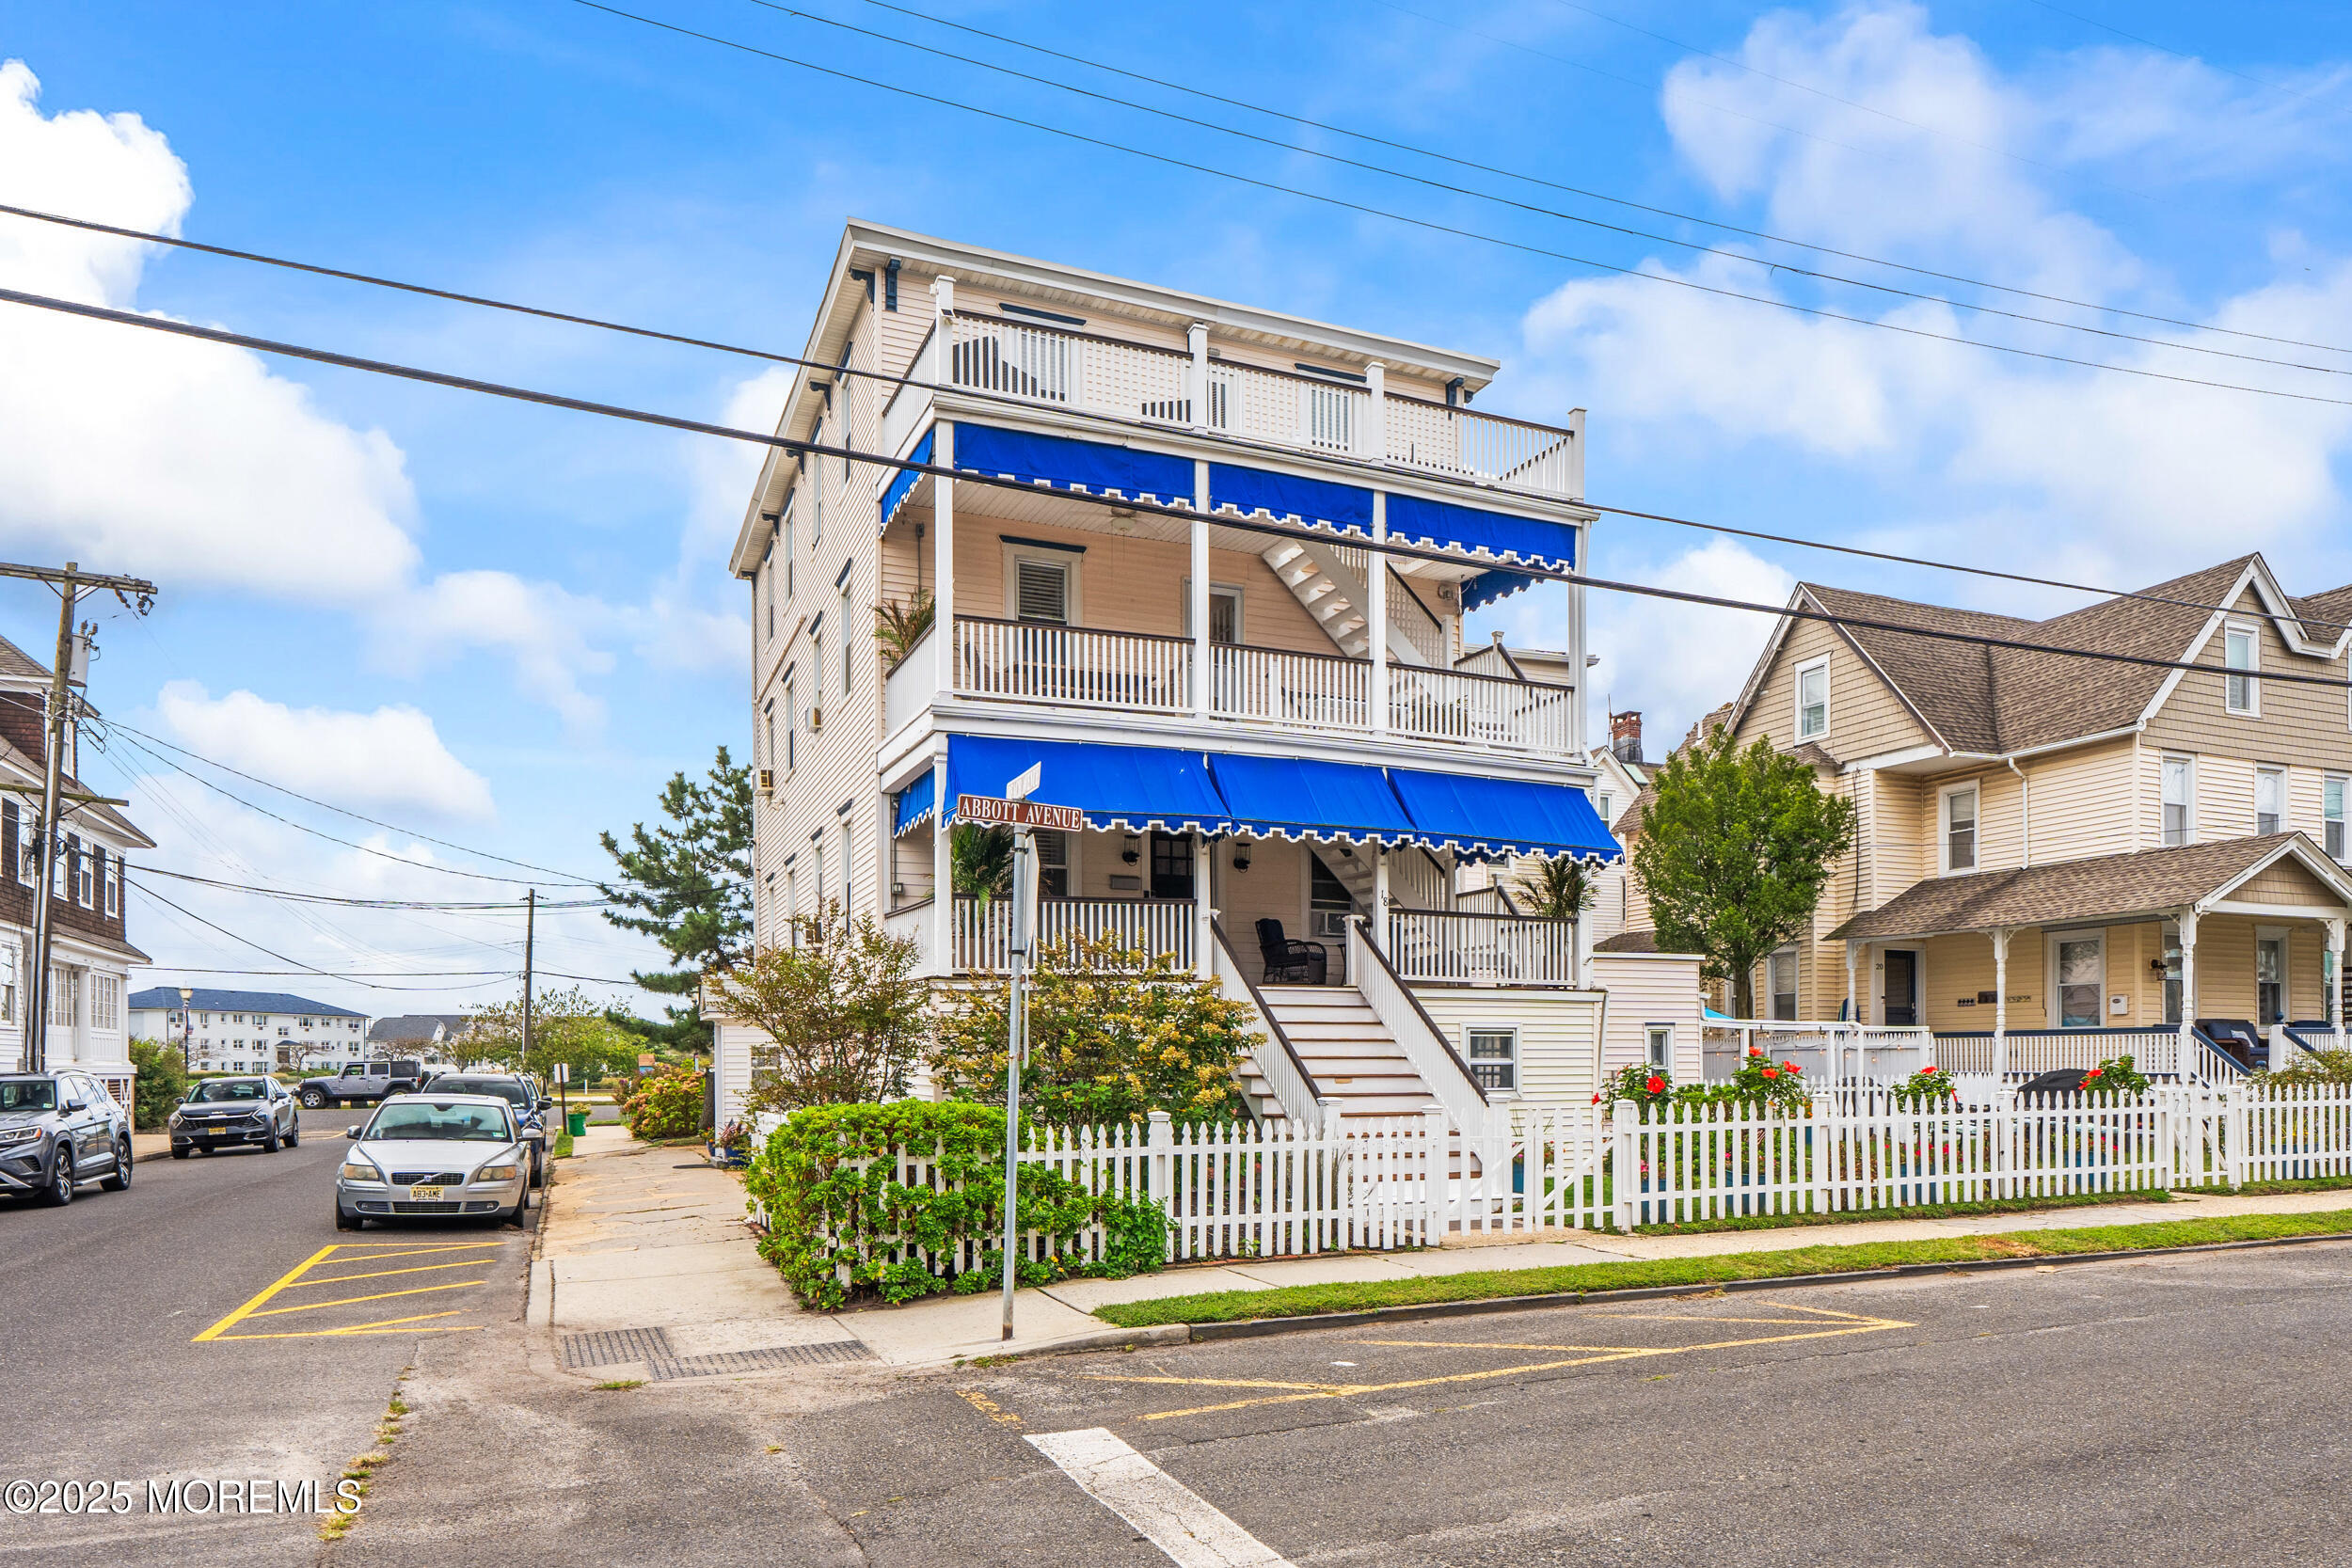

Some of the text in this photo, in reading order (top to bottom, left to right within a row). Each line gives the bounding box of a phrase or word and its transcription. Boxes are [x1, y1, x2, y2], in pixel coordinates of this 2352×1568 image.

[961, 798, 1080, 829] ABBOTT AVENUE
[1381, 889, 1389, 906] 18
